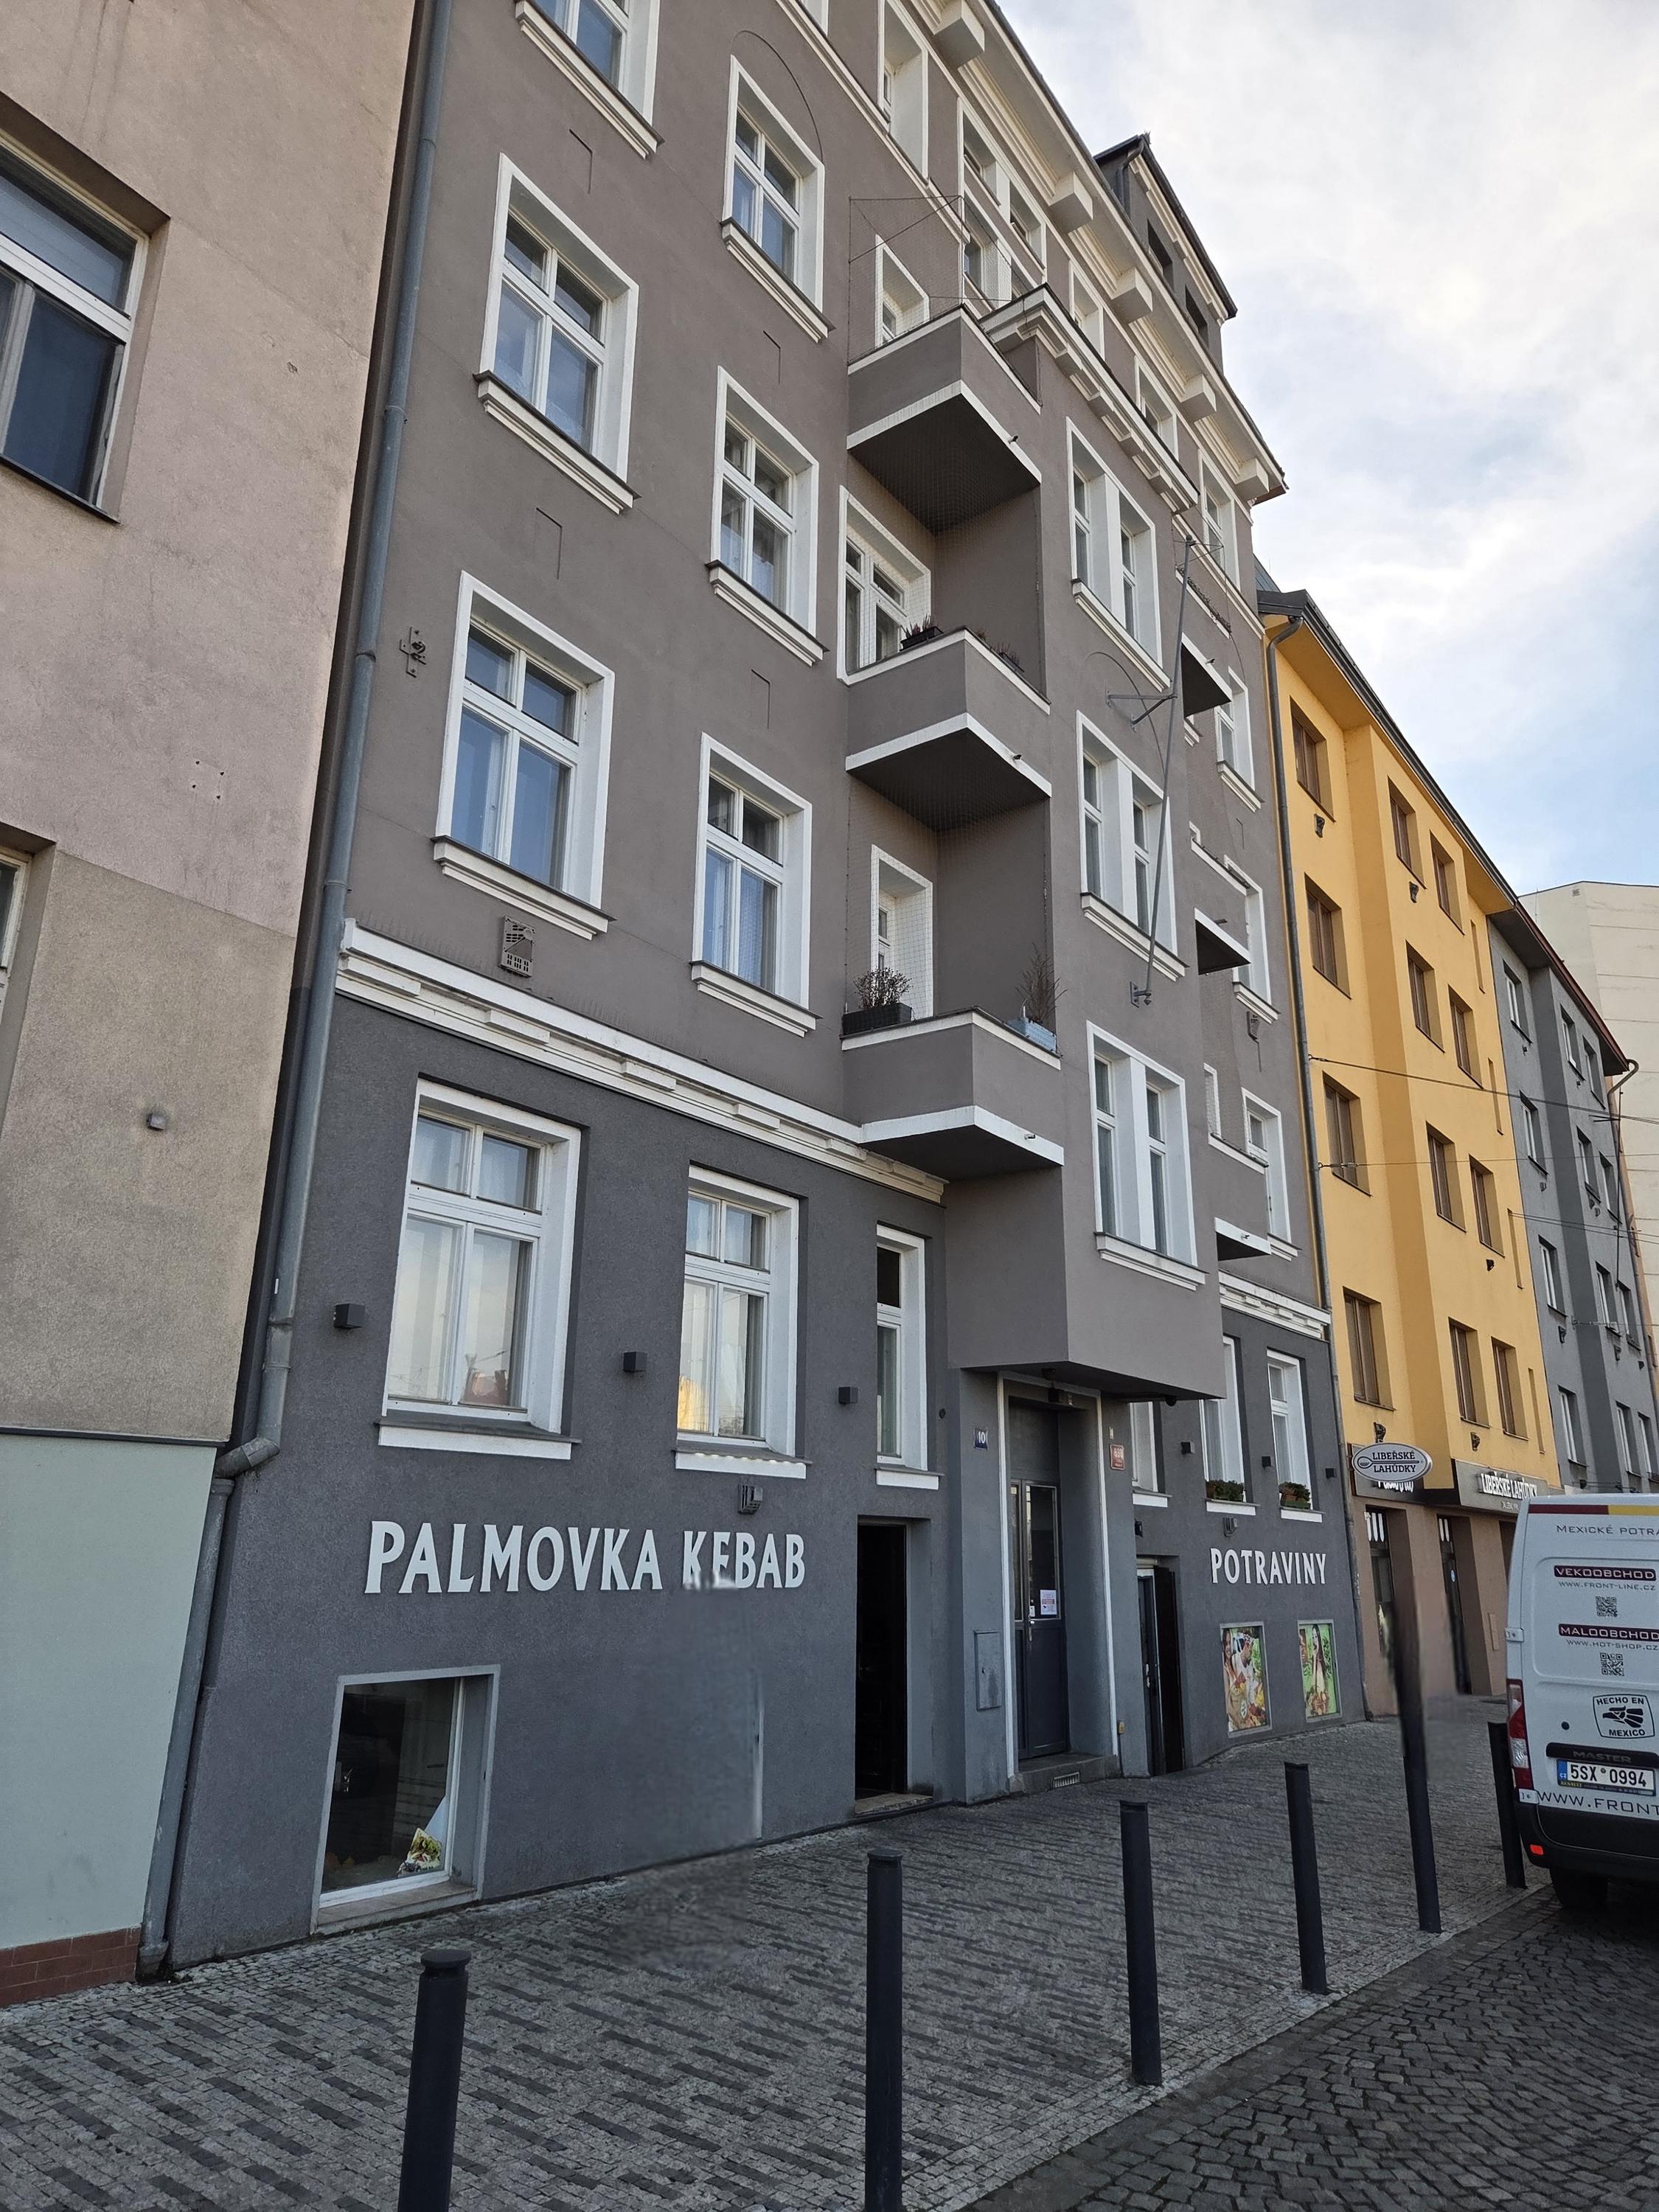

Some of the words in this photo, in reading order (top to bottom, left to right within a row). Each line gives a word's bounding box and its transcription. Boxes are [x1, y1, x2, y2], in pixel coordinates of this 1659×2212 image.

[1372, 1450, 1415, 1460] LIBEŘSKÉ
[1374, 1464, 1416, 1472] LAHŮDKY
[1557, 1524, 1613, 1534] MEXICKÉ
[364, 1520, 663, 1594] PALMOVKA
[682, 1530, 806, 1592] KEBAB
[1210, 1548, 1326, 1585] POTRAVINY
[1555, 1568, 1655, 1579] VEKOOBCHOD
[1560, 1627, 1659, 1640] MALOOBCHOD
[1596, 1697, 1628, 1705] HECHO
[1632, 1697, 1644, 1705] EN
[1609, 1729, 1646, 1737] MEXICO
[1573, 1751, 1632, 1764] MASTER
[1571, 1764, 1598, 1782] 5SX
[1610, 1769, 1646, 1787] 0994
